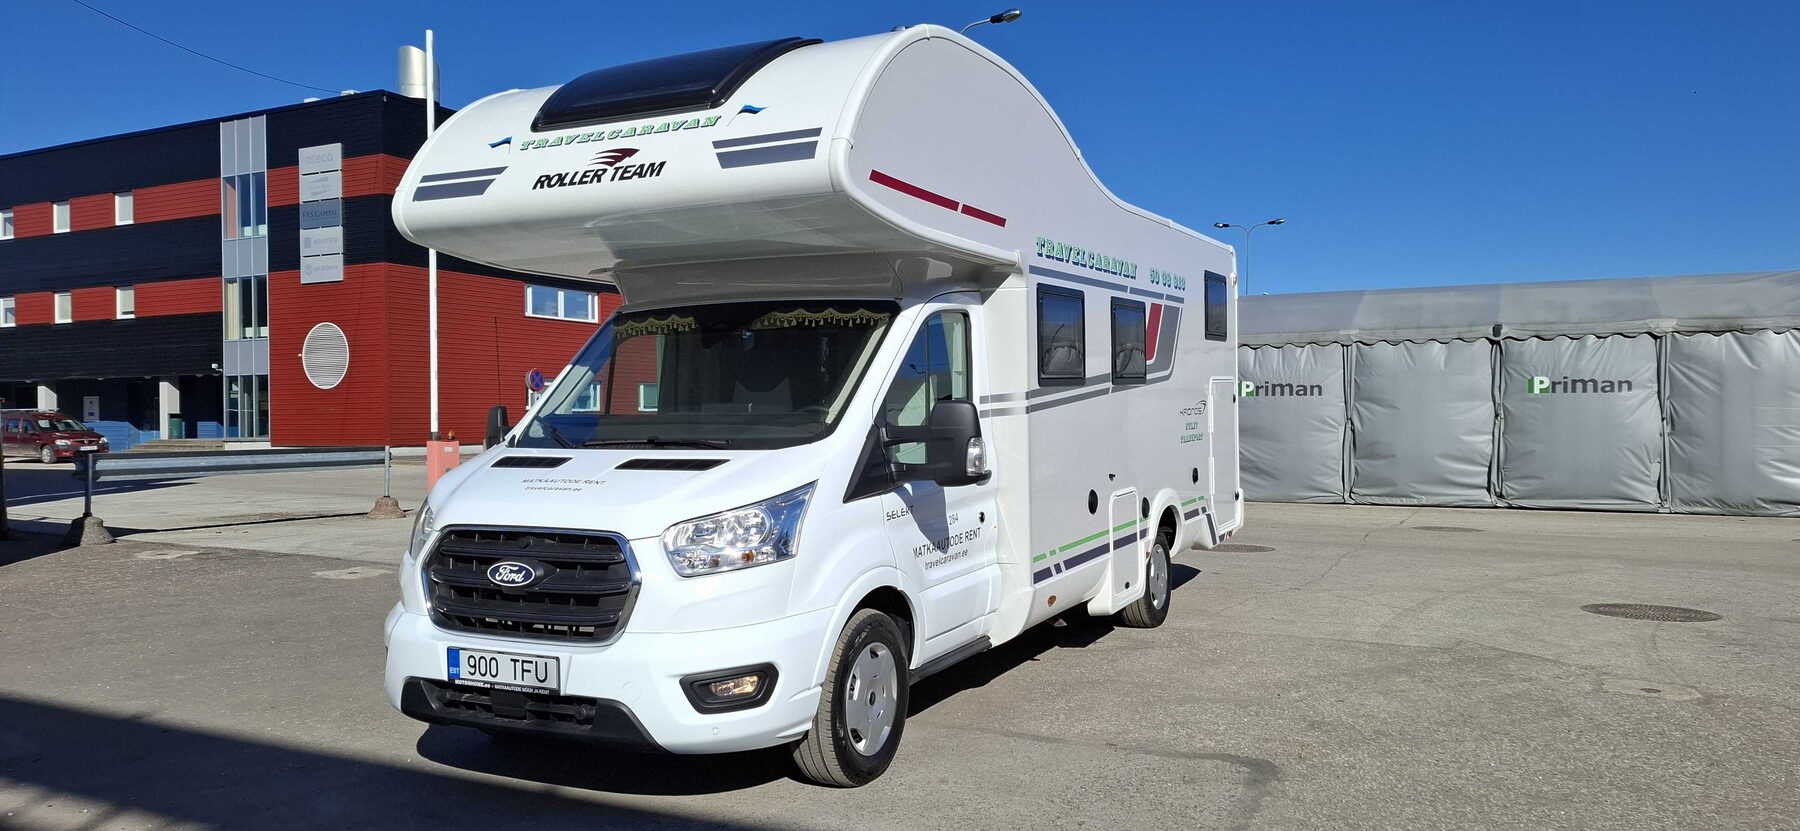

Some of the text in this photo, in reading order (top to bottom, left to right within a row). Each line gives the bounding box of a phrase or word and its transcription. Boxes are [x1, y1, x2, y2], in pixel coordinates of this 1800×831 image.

[519, 115, 721, 150] TRAVELCARAVAN
[532, 160, 667, 190] ROLLER TEAM
[1035, 236, 1138, 280] TRAVELCARAVAN
[1241, 380, 1323, 398] Priman
[1532, 376, 1633, 395] Priman
[912, 527, 981, 559] MATKAAUTODE RENT
[925, 549, 968, 570] travelcaravan.ee
[495, 566, 525, 583] Ford
[450, 666, 460, 674] EST
[467, 654, 548, 683] 900 TFU
